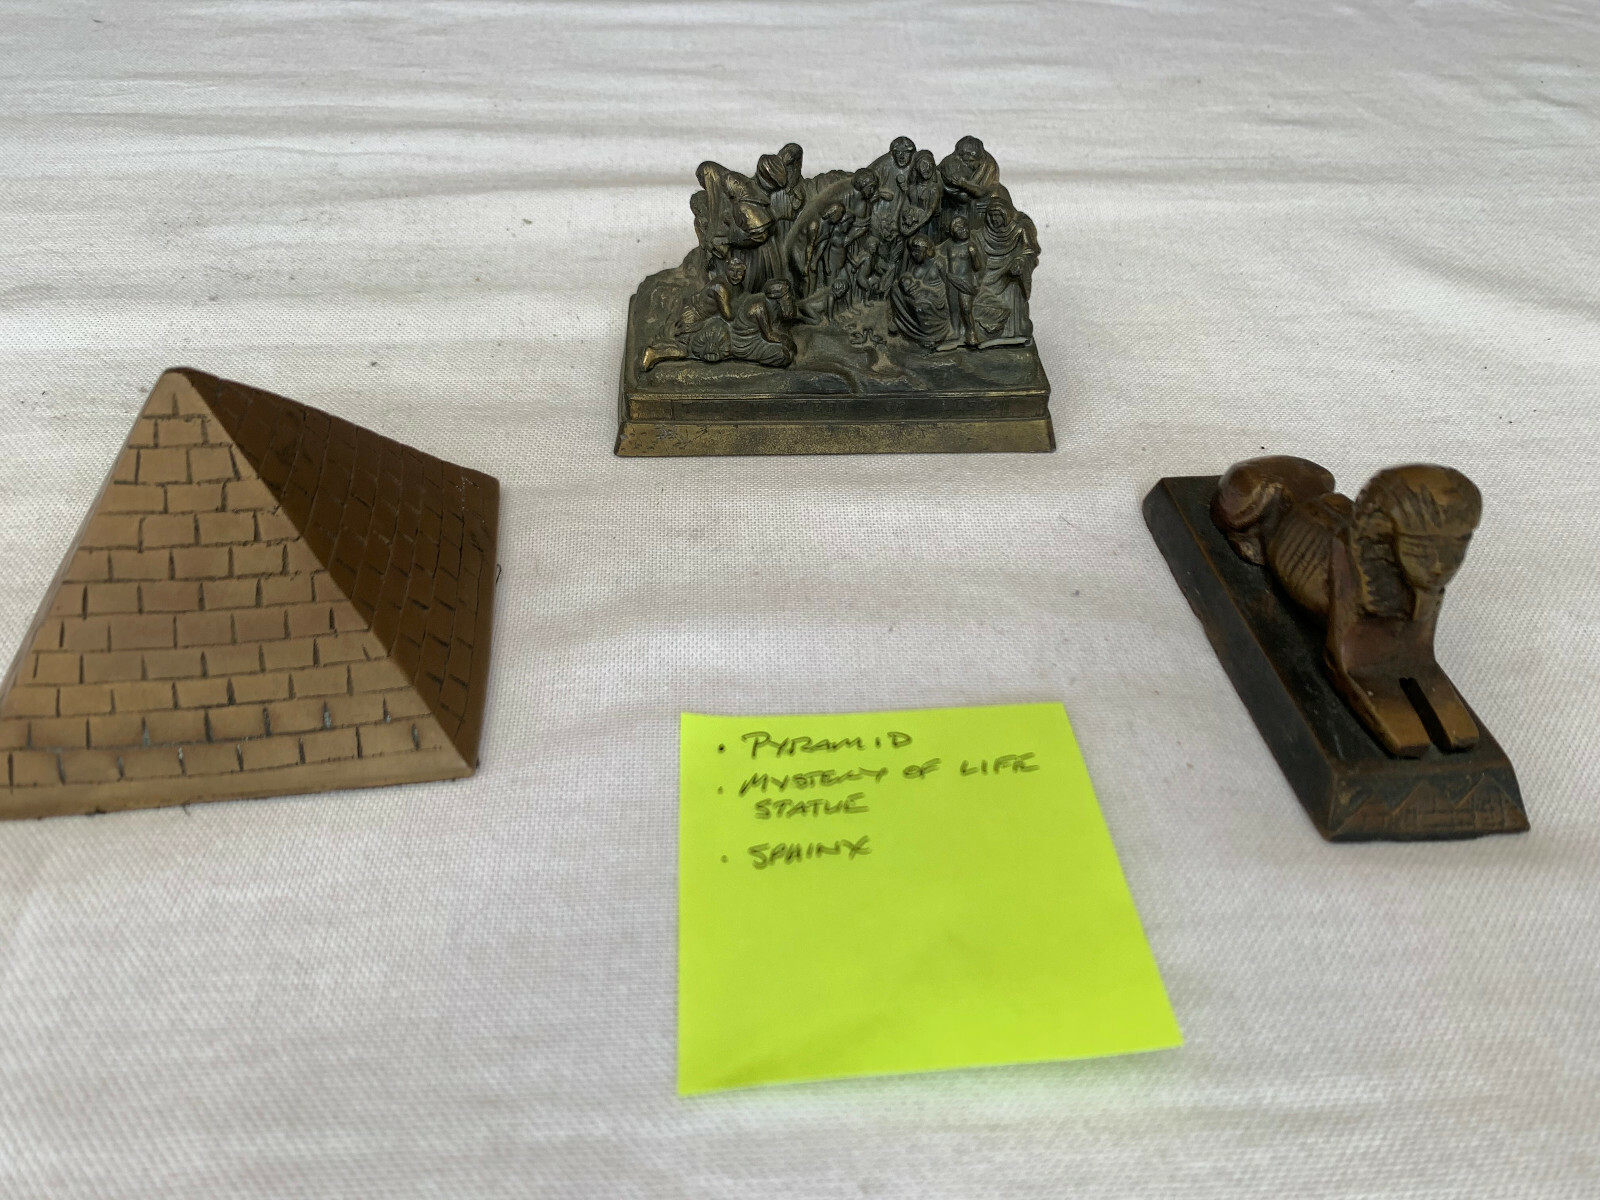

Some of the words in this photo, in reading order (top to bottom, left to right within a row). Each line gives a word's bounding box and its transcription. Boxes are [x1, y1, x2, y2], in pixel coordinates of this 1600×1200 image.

[741, 731, 913, 758] PYRAMID
[739, 766, 889, 797] MYSTERY
[903, 758, 940, 779] OF
[959, 752, 1040, 776] LIFE
[755, 792, 870, 820] STATUE
[748, 836, 871, 870] SPHINX
